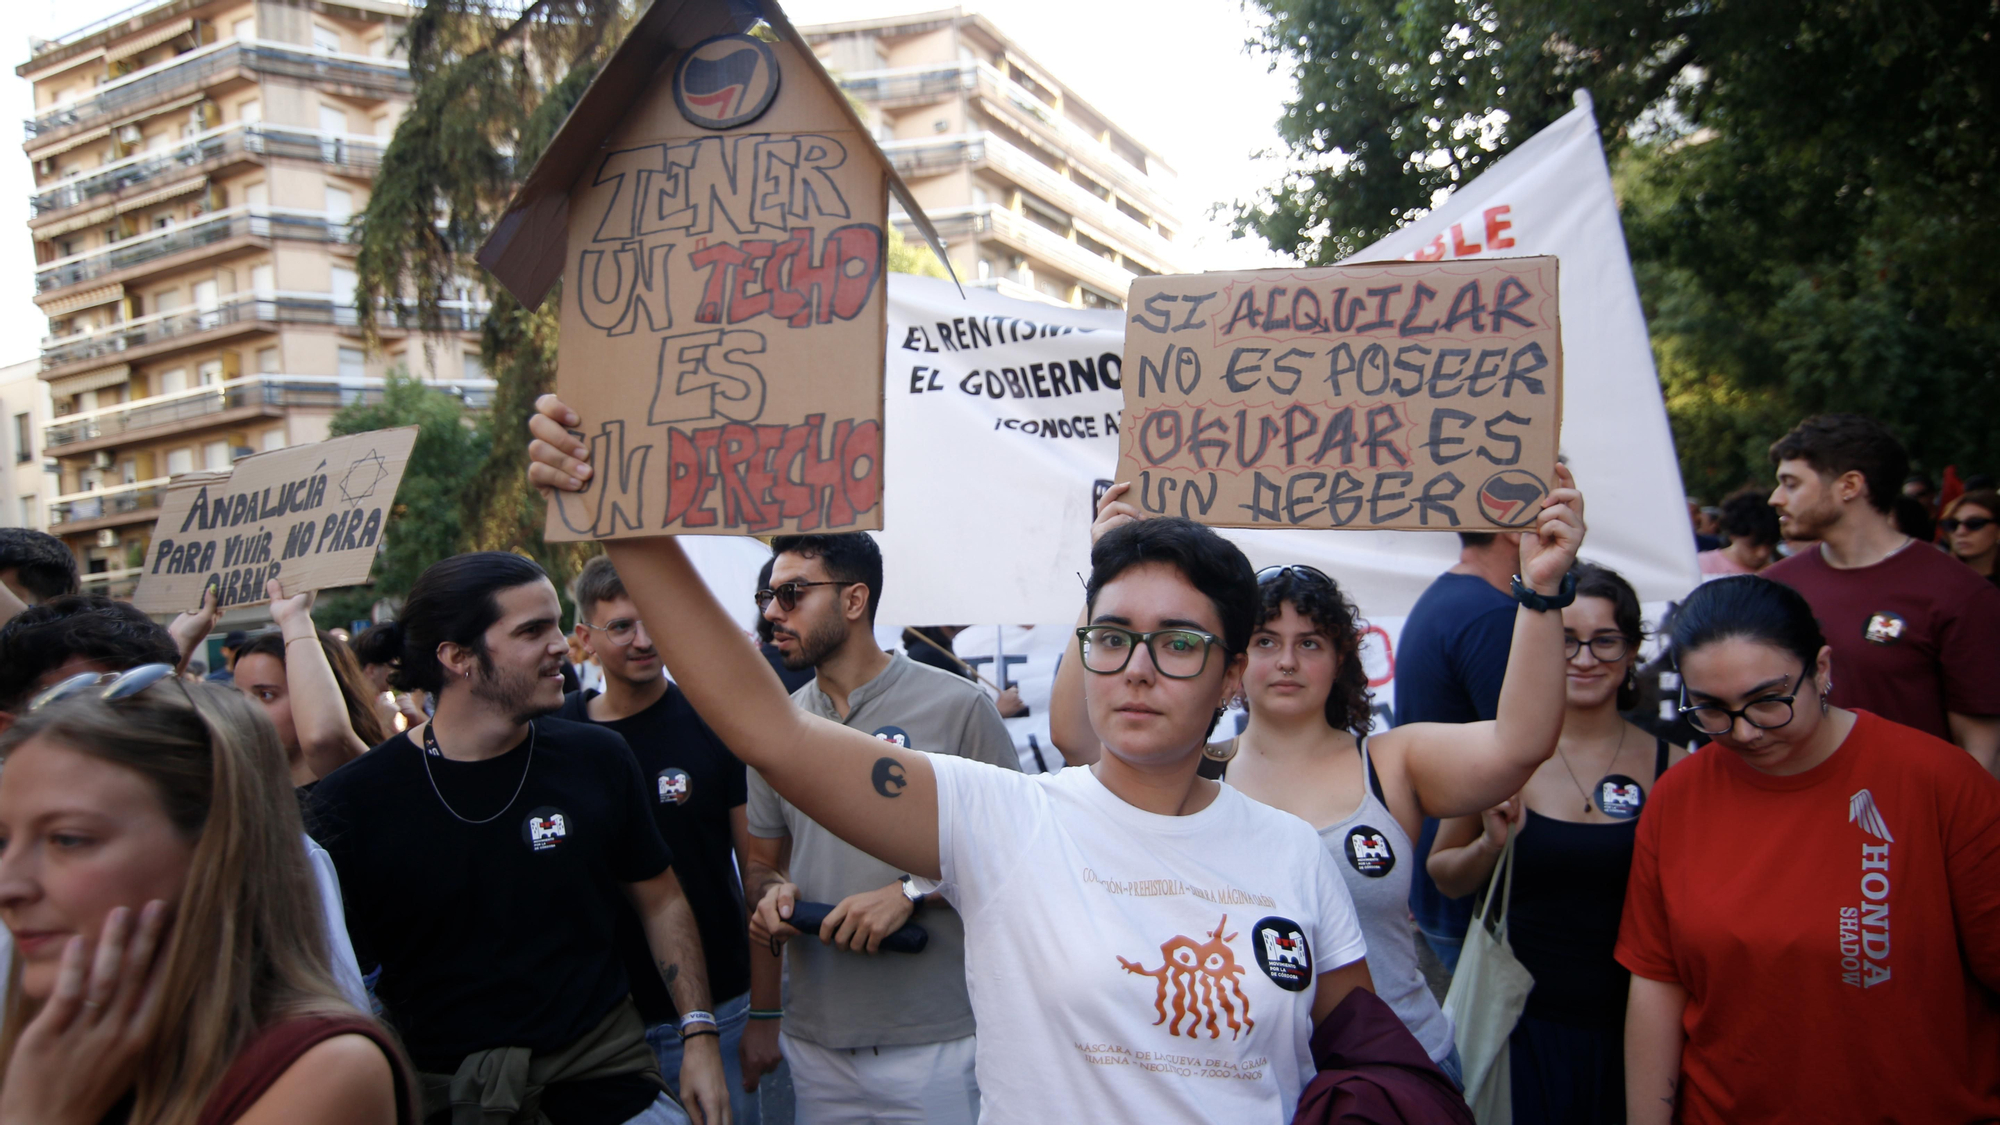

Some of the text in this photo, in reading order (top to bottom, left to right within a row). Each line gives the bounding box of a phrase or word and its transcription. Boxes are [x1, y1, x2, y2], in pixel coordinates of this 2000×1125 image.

[592, 133, 851, 243] TENER
[1396, 204, 1515, 261] BLE
[578, 222, 883, 337] UN TECHO
[1131, 275, 1537, 338] SI ALQUILAR
[902, 326, 939, 353] EL
[1138, 341, 1549, 399] NO ES POSEER
[647, 327, 767, 426] ES
[910, 352, 1122, 399] EL GOBIERNO
[1139, 404, 1532, 469] OKUPAR ES
[179, 458, 328, 533] ANDALUCÍA
[553, 412, 880, 538] UN DERECHO
[1139, 470, 1466, 526] UN DEBER
[151, 538, 217, 575] PARA
[281, 521, 316, 561] NO
[314, 507, 382, 554] PARA
[1840, 907, 1861, 988] SHADOW
[1861, 843, 1891, 988] HONDA
[1074, 1041, 1132, 1056] MÁSCARA
[1135, 1051, 1151, 1060] DE
[1205, 1059, 1220, 1068] DE
[1223, 1061, 1238, 1071] LA
[1201, 1069, 1231, 1078] 7.000
